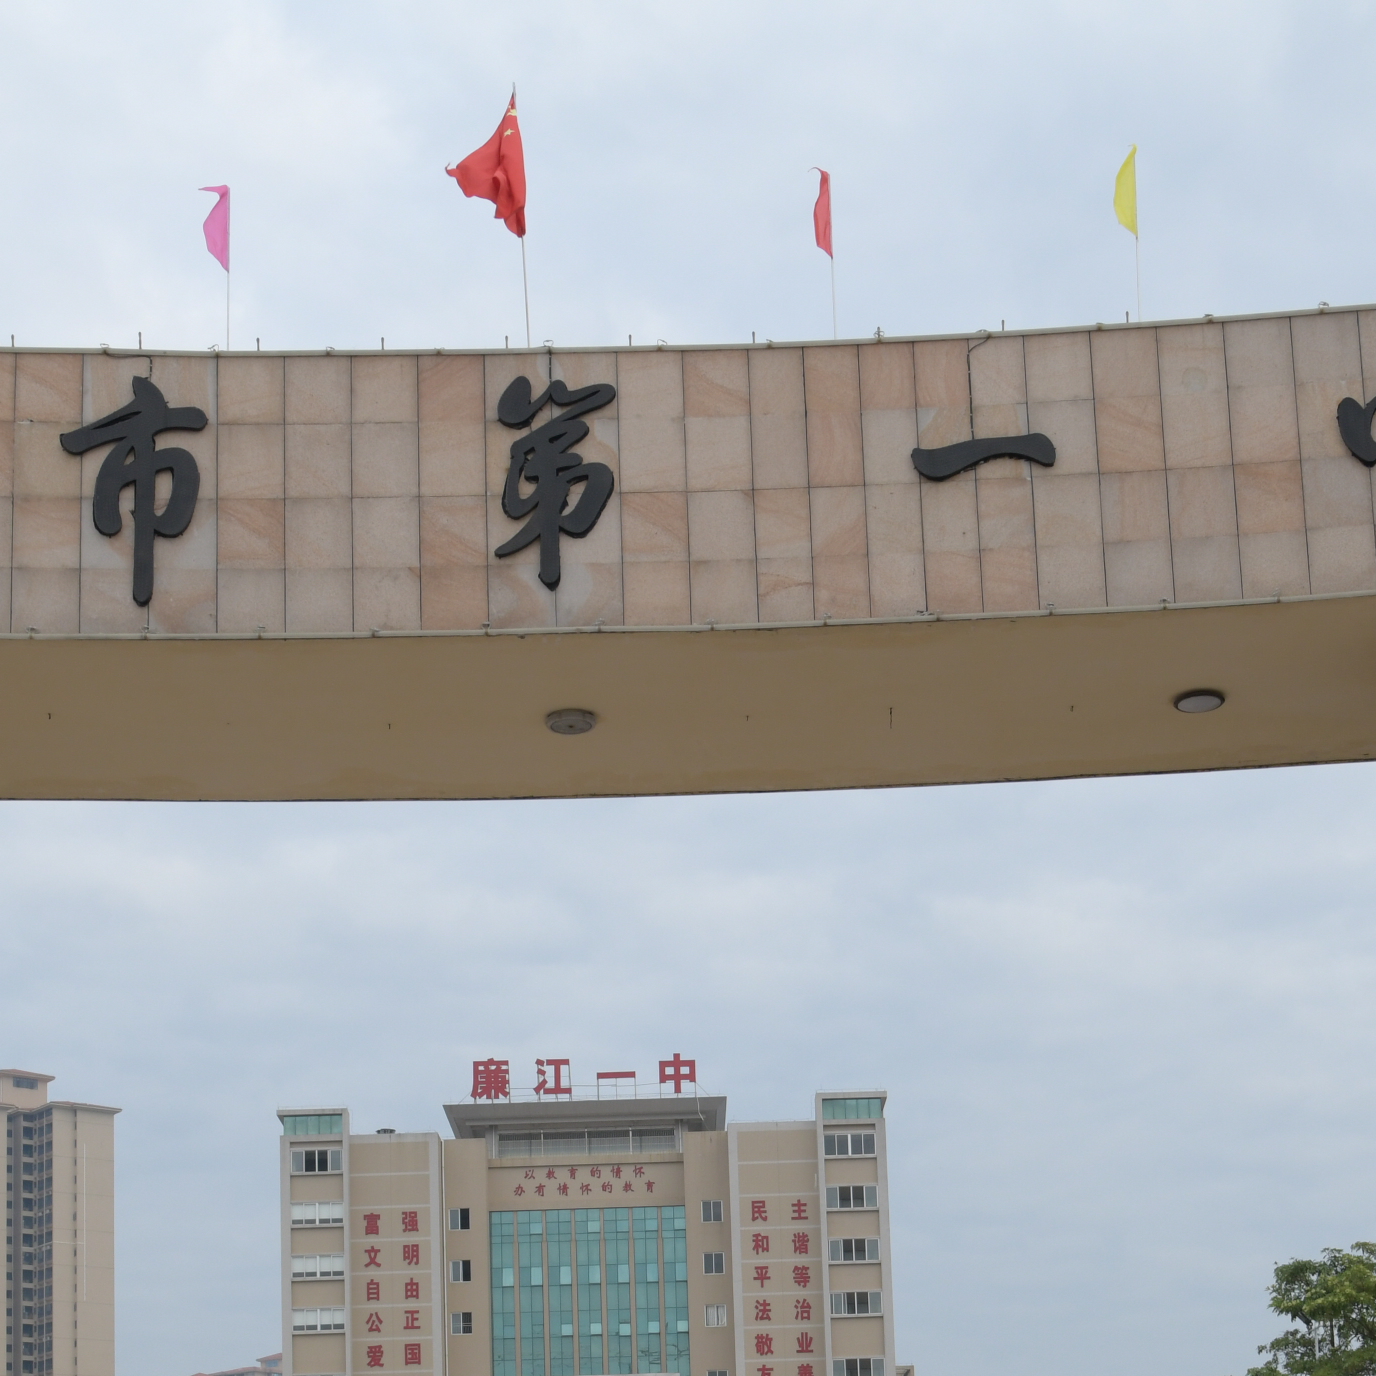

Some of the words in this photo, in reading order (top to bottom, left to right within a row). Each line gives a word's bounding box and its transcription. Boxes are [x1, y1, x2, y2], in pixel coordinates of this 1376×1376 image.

[470, 1053, 697, 1100] 廉江一中
[523, 1165, 646, 1180] 以教育的情怀
[513, 1180, 656, 1197] 办有情怀的教育
[751, 1199, 809, 1222] 民主
[363, 1211, 420, 1236] 富强
[752, 1232, 810, 1255] 和谐
[364, 1244, 420, 1268] 文明
[753, 1265, 811, 1288] 平等
[366, 1277, 420, 1301] 自由
[754, 1298, 812, 1321] 法治
[365, 1310, 421, 1333] 公正
[366, 1343, 422, 1368] 爱国
[755, 1332, 814, 1356] 敬业
